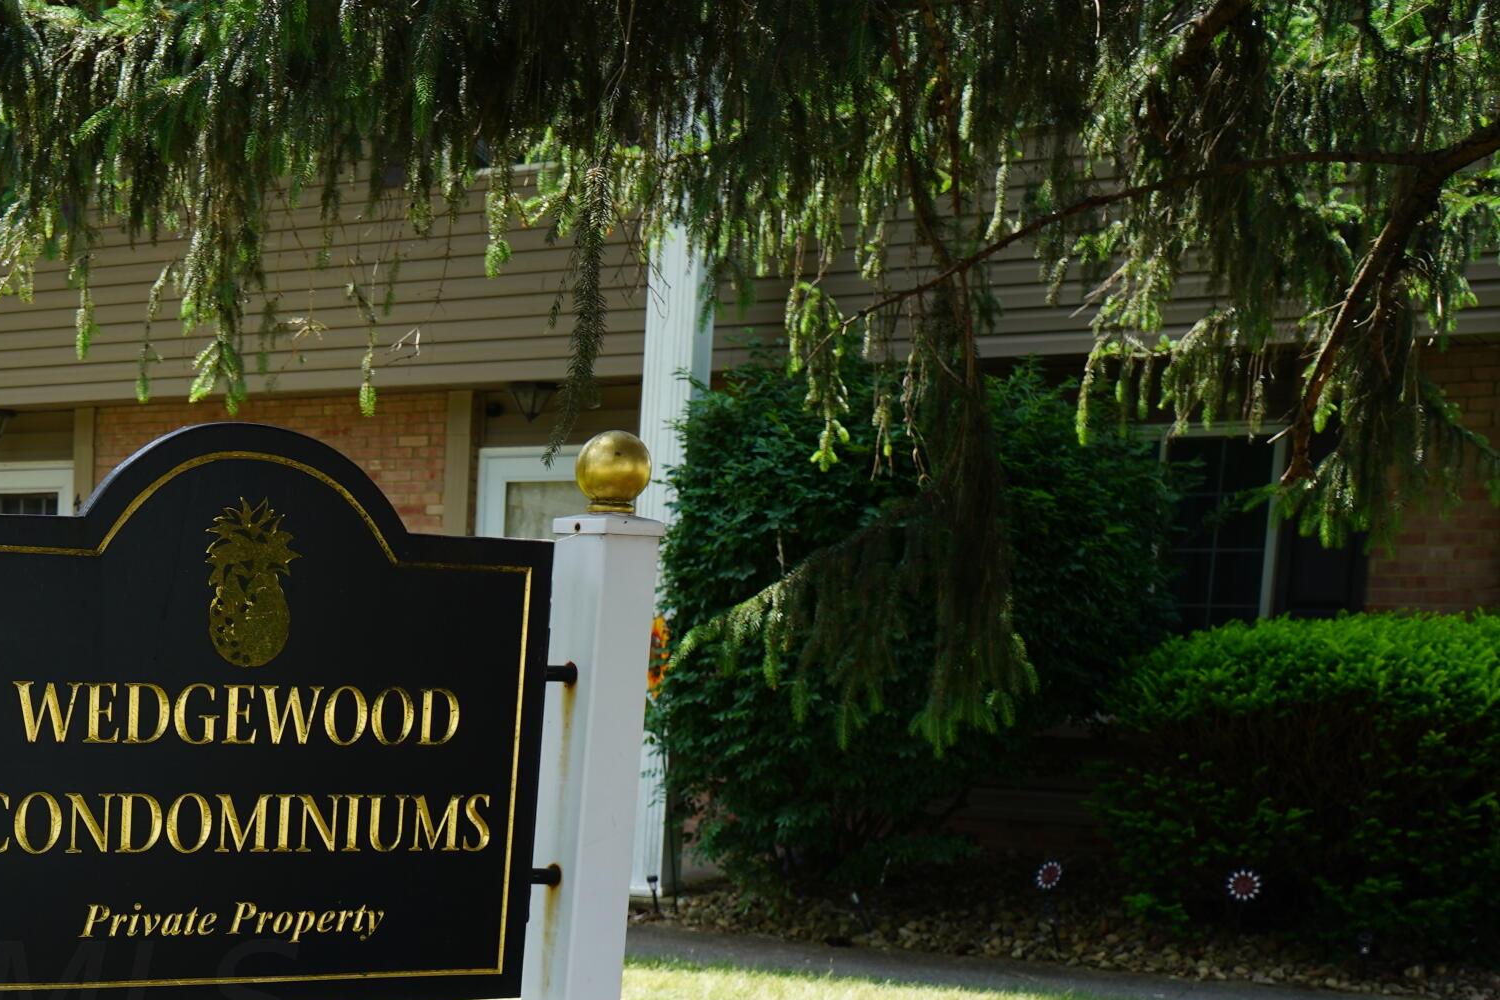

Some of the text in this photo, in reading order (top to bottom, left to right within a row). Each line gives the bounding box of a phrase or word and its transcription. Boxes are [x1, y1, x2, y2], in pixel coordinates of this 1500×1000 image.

[13, 681, 462, 746] WEDGEWOOD
[78, 901, 385, 945] Private Property
